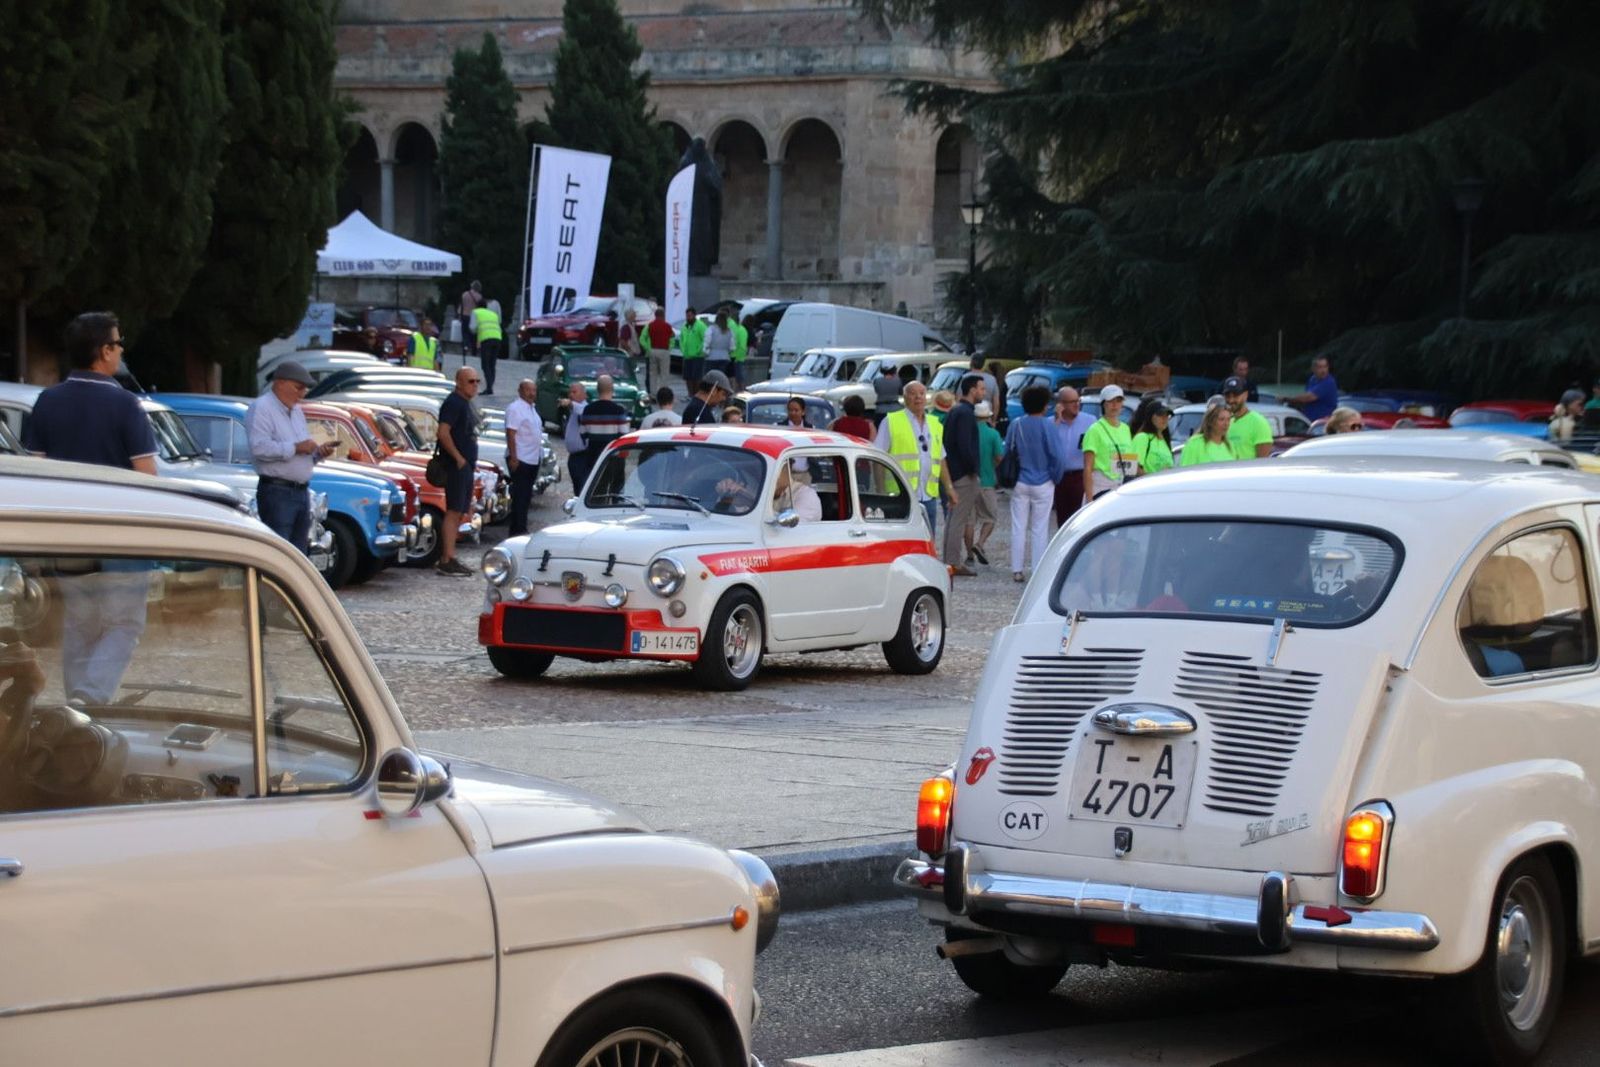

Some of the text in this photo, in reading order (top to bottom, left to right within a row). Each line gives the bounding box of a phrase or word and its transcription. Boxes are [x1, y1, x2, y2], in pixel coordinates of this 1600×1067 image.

[556, 173, 581, 274] SEAT
[672, 202, 680, 275] CUPRA
[719, 556, 769, 570] FIAT ABARTH
[1214, 599, 1273, 609] SEAT
[1082, 779, 1176, 820] 4707
[1004, 811, 1044, 830] CAT
